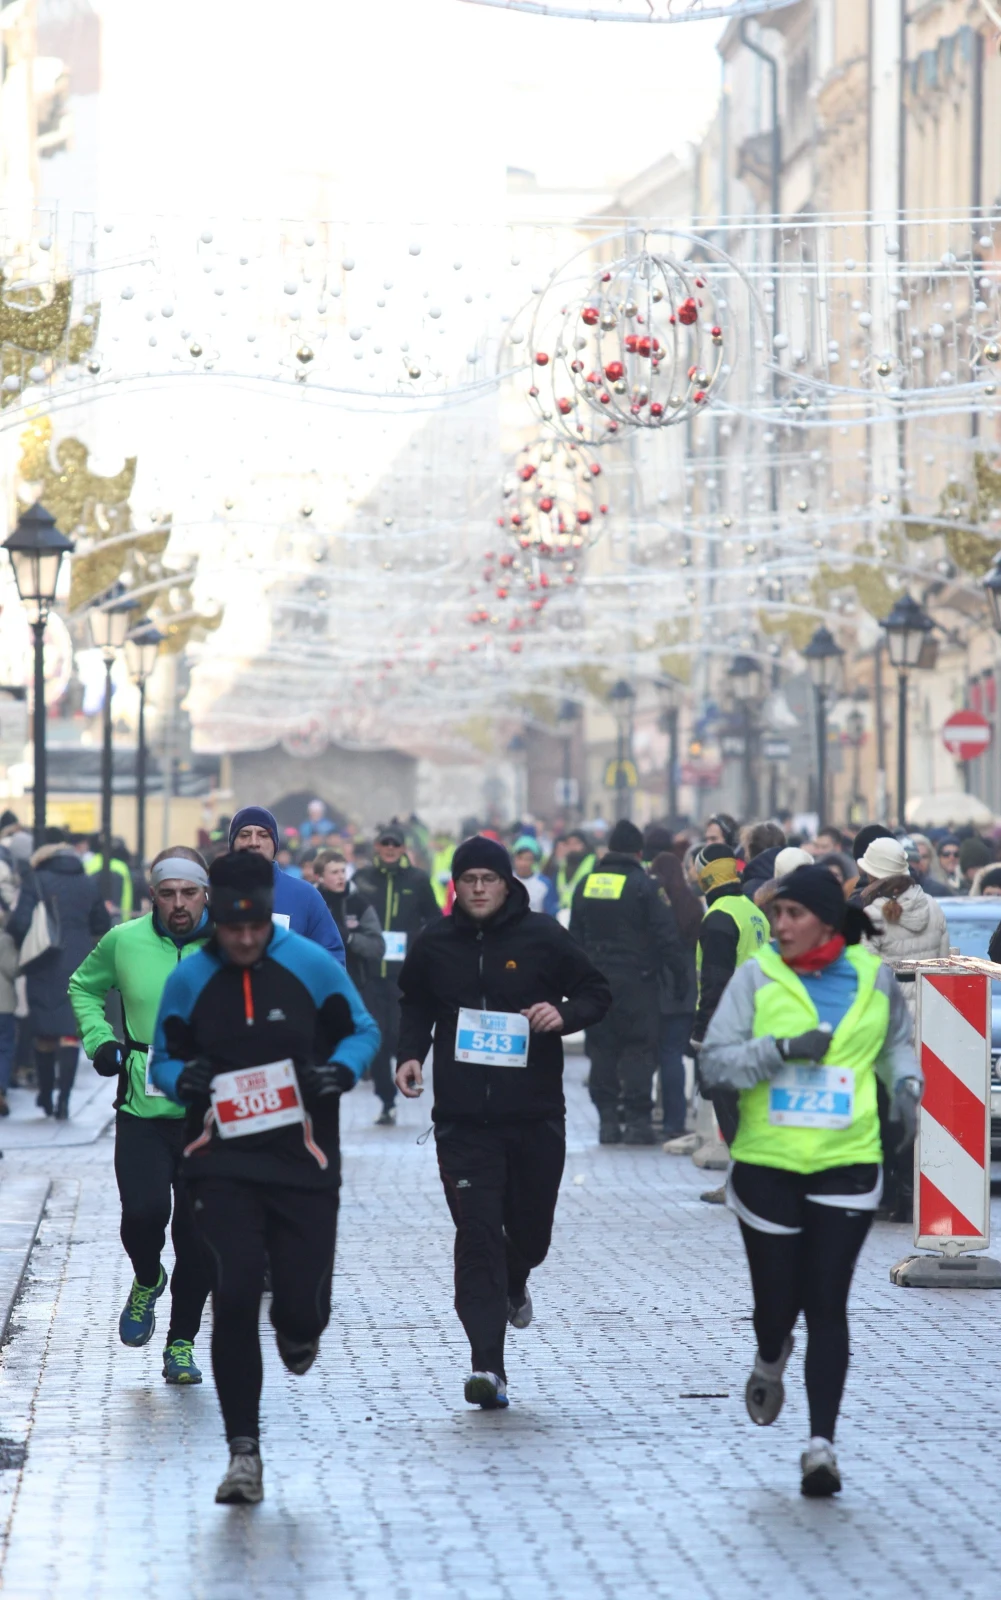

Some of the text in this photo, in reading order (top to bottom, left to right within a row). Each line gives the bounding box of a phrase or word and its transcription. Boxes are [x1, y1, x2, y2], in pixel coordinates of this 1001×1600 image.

[471, 1032, 512, 1053] 543
[231, 1089, 282, 1117] 308
[786, 1089, 835, 1112] 724
